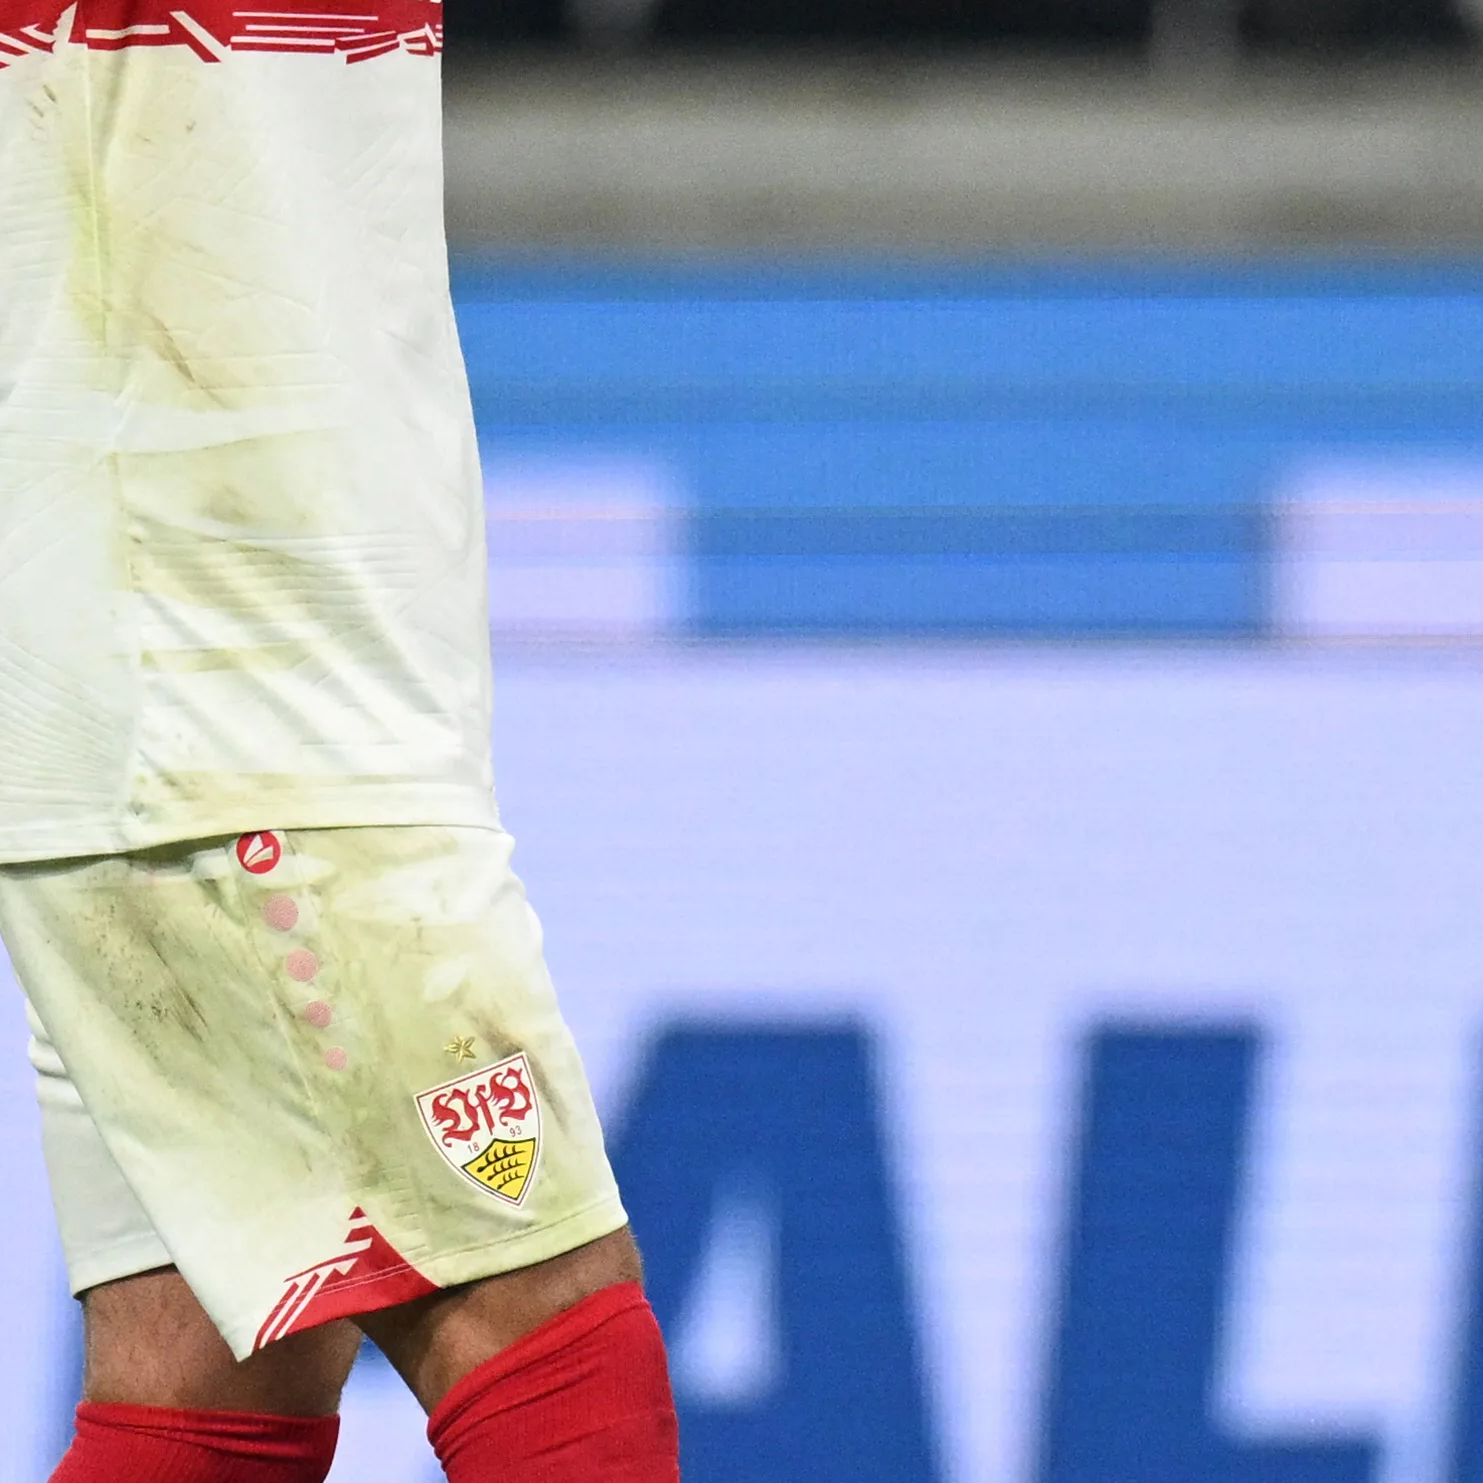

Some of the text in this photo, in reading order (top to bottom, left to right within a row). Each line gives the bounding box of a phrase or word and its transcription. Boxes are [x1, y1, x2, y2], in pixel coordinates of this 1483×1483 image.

[431, 1067, 533, 1148] VfB
[467, 1124, 522, 1154] 18 93
